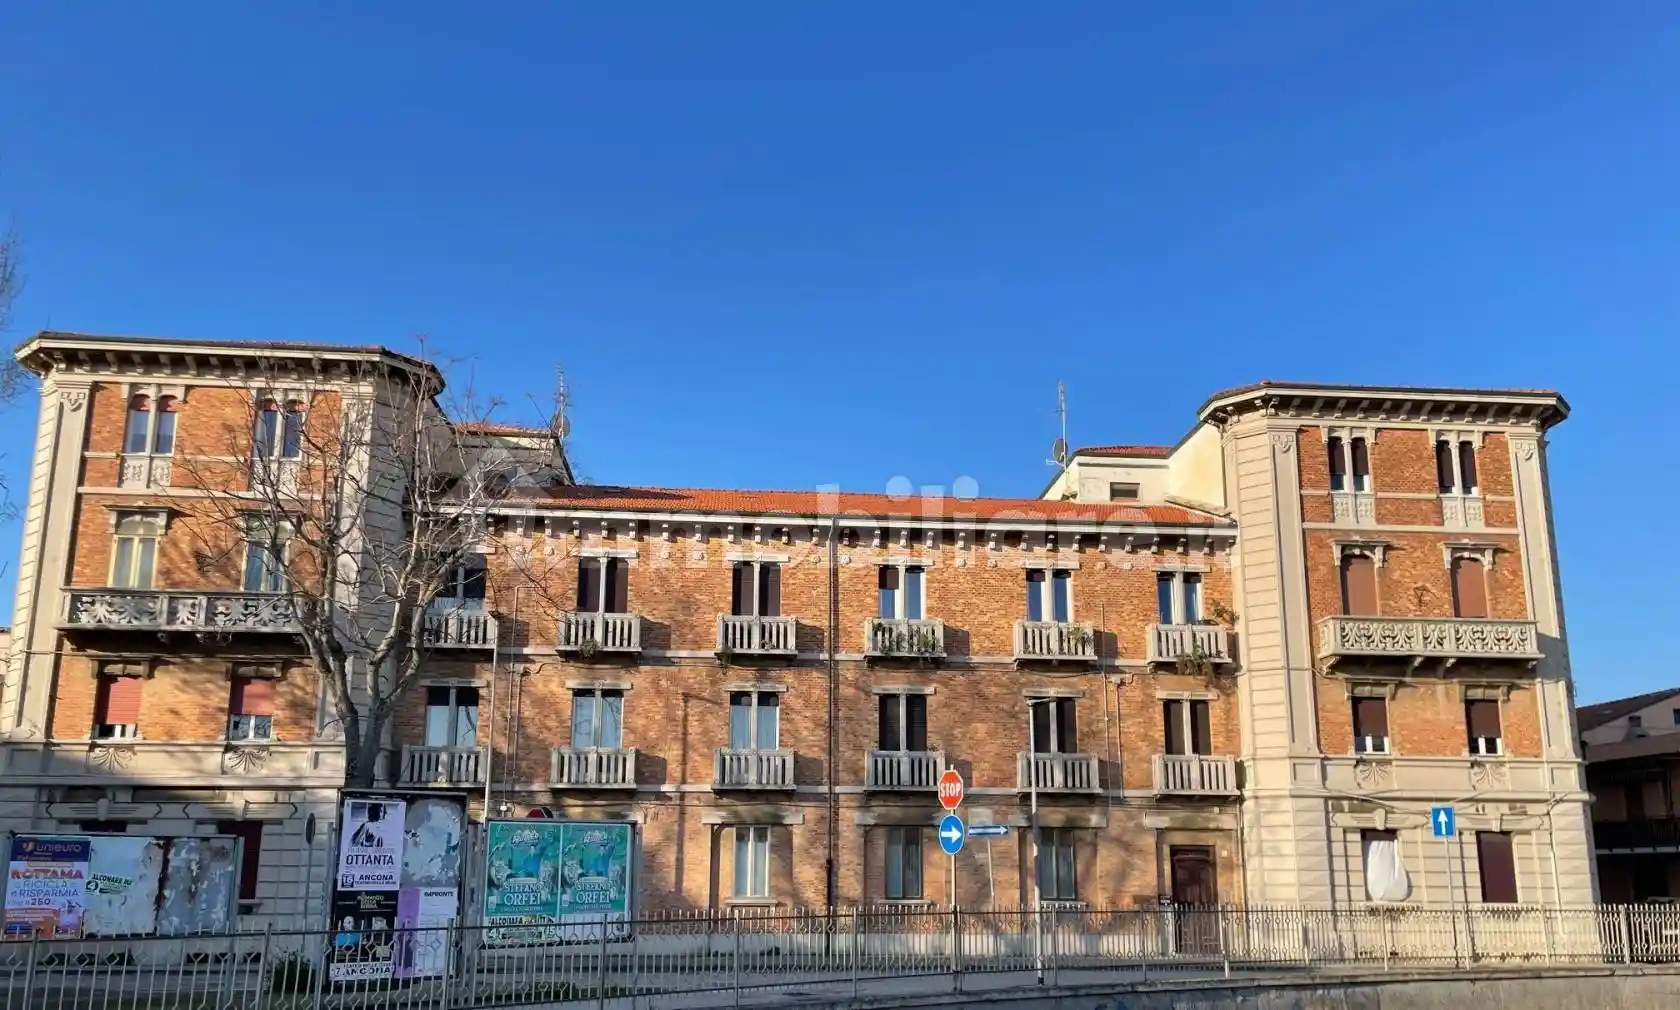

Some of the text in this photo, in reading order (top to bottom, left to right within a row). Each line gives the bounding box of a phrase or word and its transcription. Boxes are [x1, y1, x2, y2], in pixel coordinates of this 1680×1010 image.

[940, 783, 960, 797] STOP
[346, 854, 394, 865] OTTANTA
[503, 882, 541, 892] STEFANO
[575, 882, 612, 891] STEFANO
[19, 889, 79, 897] RISPARMIA
[504, 892, 541, 905] ORFEI
[576, 891, 610, 904] ORFEI
